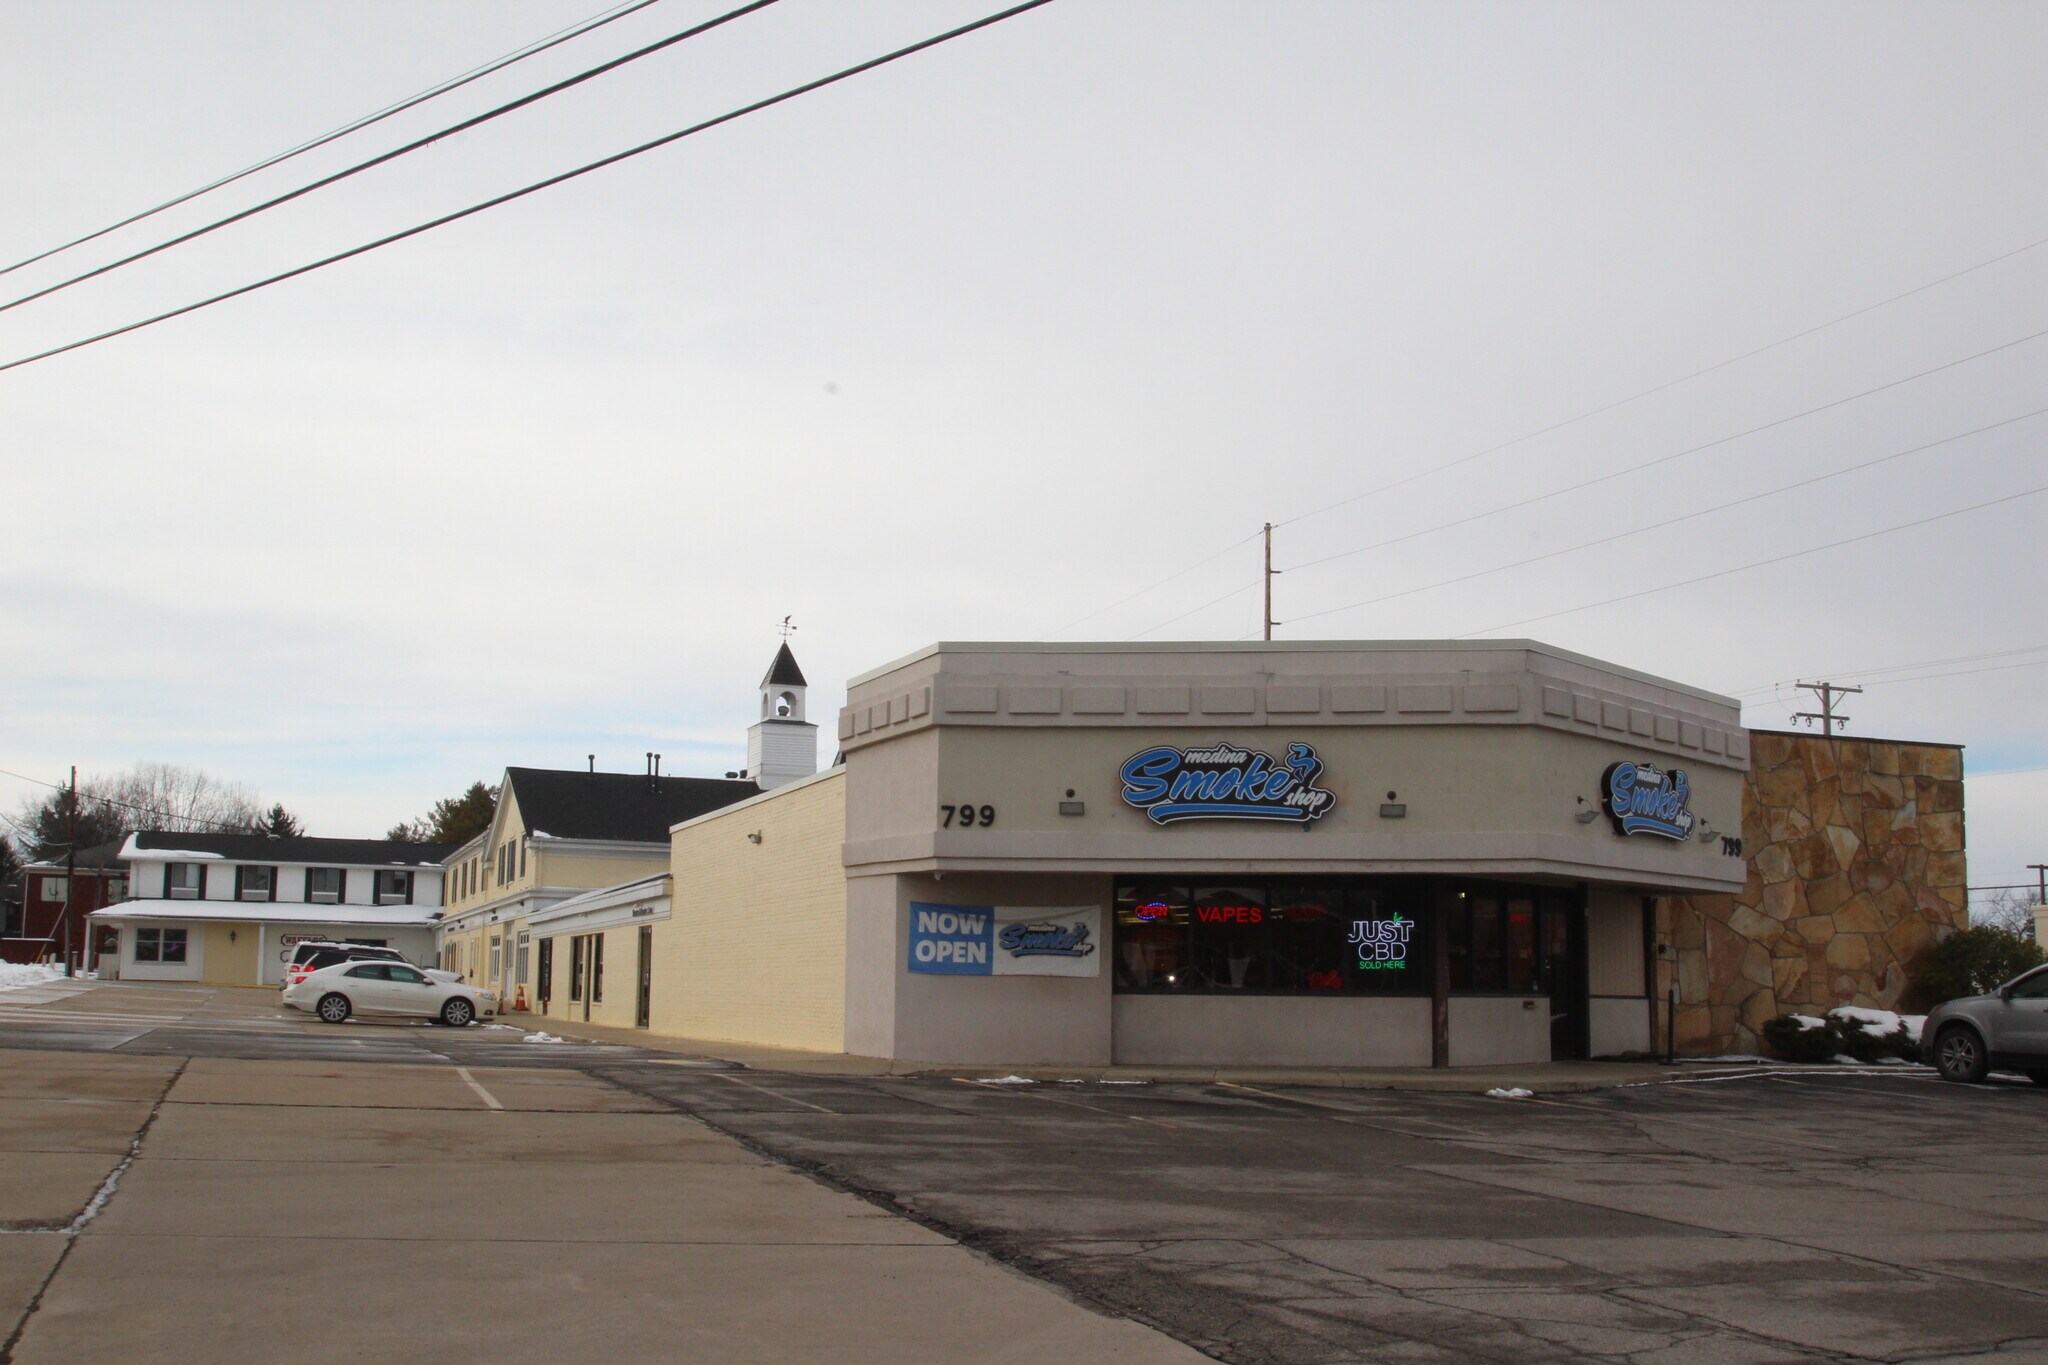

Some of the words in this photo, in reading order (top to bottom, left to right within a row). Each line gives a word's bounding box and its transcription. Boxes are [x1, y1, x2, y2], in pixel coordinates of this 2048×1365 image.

[1185, 746, 1248, 764] medina
[1283, 786, 1327, 811] shop
[940, 804, 995, 828] 799
[1721, 836, 1742, 857] 799
[1135, 904, 1169, 917] OPEN
[1197, 906, 1262, 923] VAPES
[918, 911, 986, 935] NOW
[1348, 920, 1414, 943] JUST
[915, 940, 987, 964] OPEN
[1358, 942, 1406, 961] CBD
[1359, 961, 1381, 970] SOLD
[1383, 960, 1406, 970] HERE
